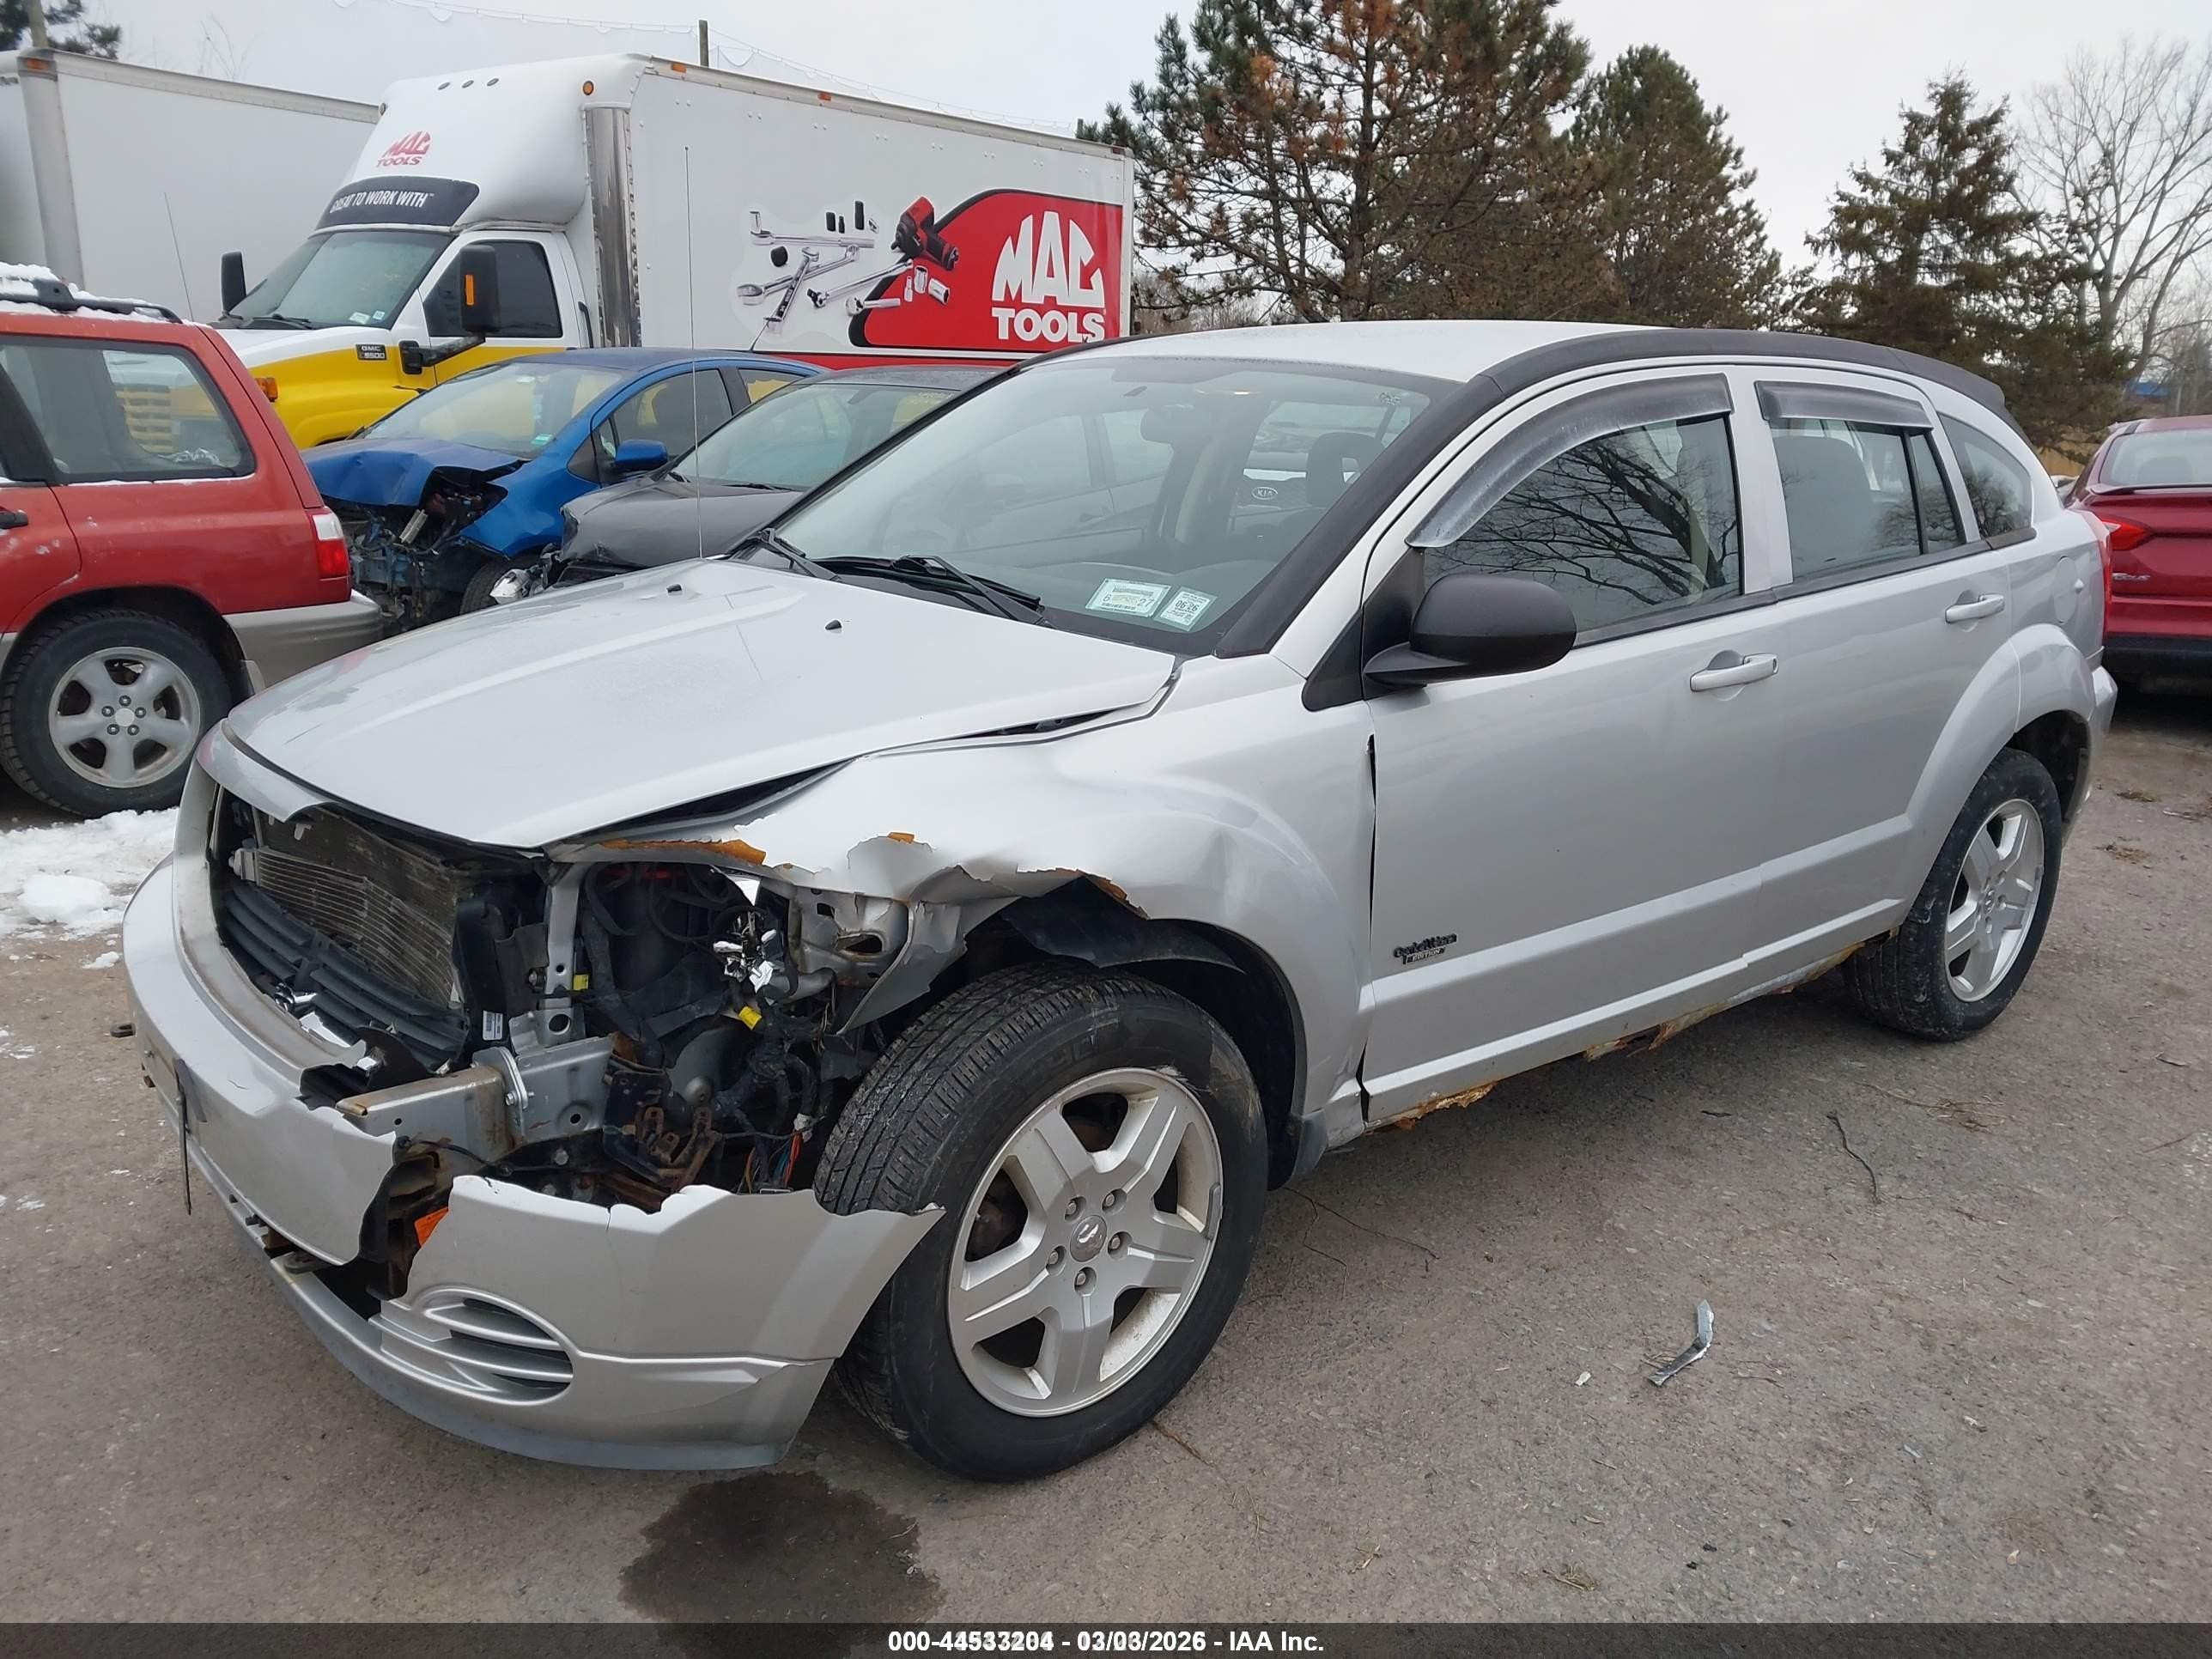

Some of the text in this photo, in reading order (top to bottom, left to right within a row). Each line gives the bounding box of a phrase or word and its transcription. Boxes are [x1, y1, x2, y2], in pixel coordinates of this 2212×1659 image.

[382, 131, 431, 158] MAC
[376, 156, 422, 168] TOOLS
[352, 192, 367, 206] TO
[365, 191, 398, 206] WORK
[992, 211, 1105, 308] MAC
[992, 307, 1105, 343] TOOLS
